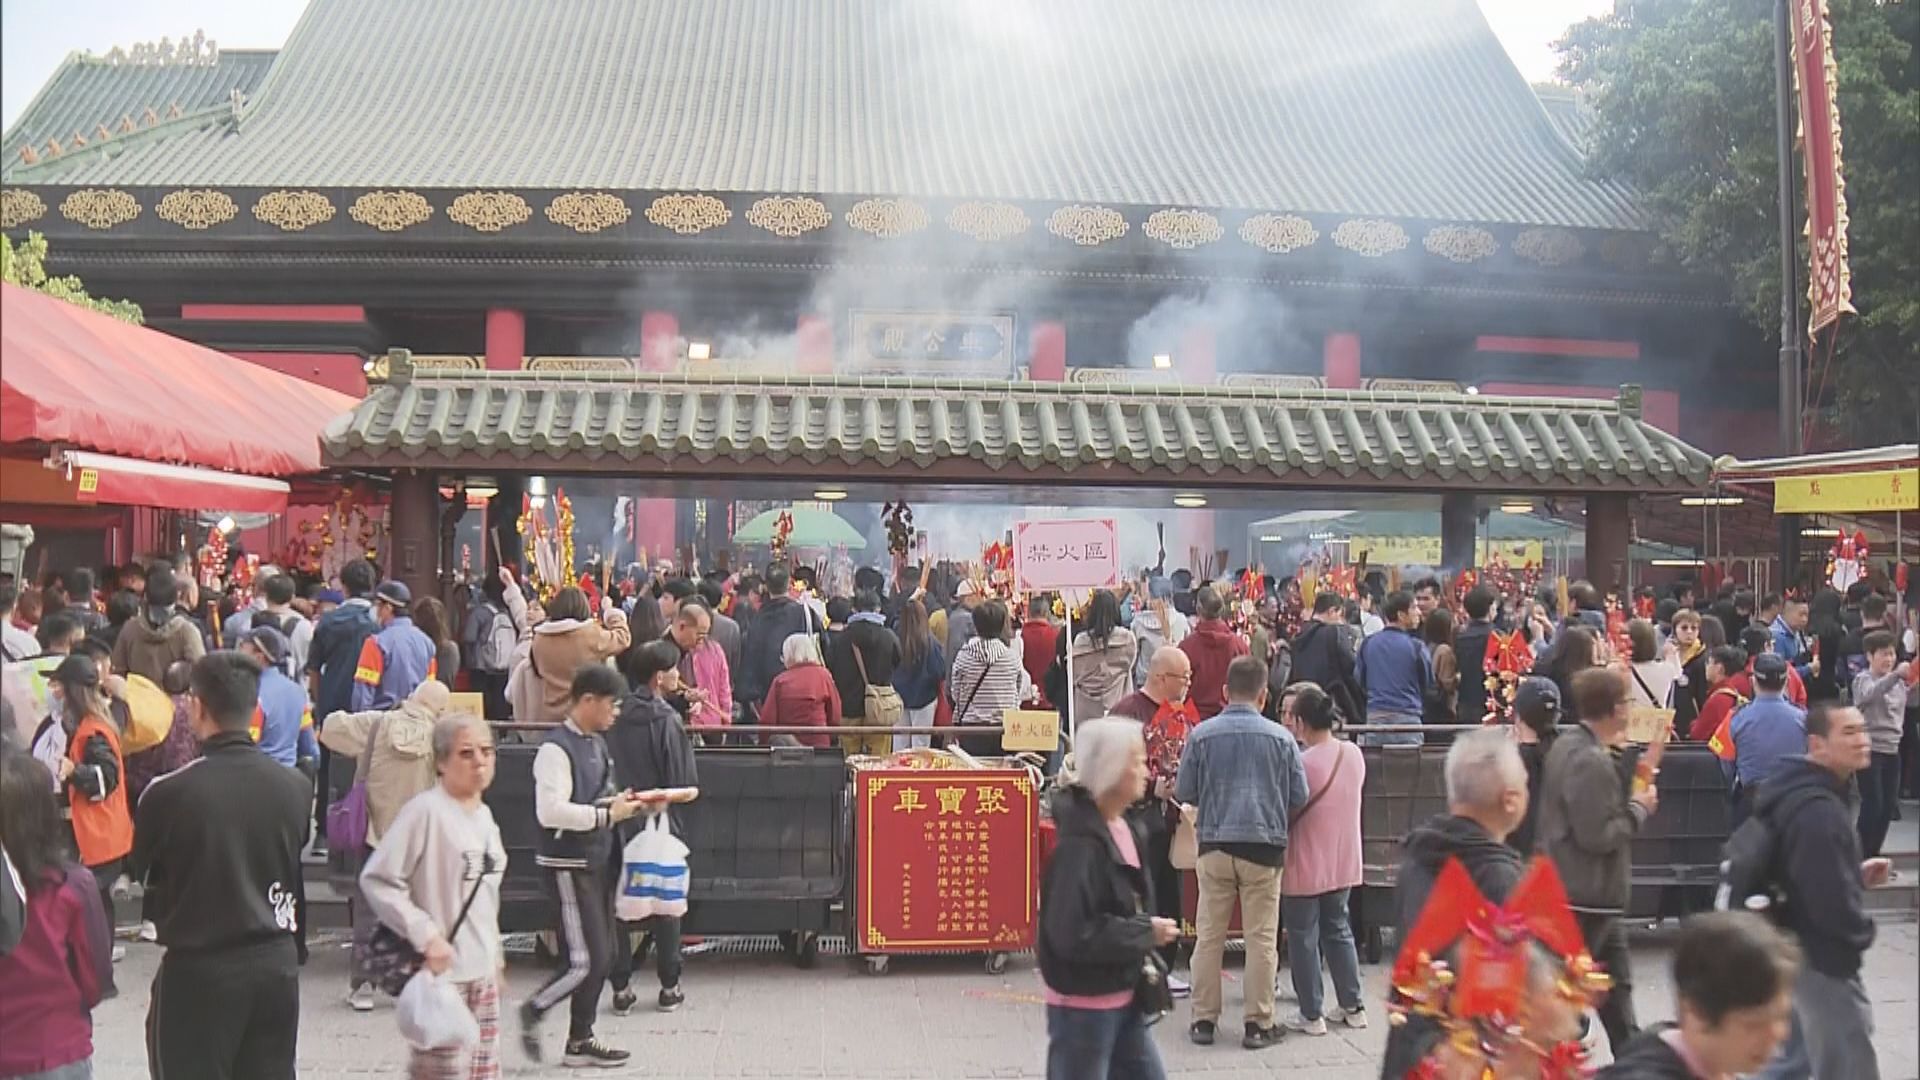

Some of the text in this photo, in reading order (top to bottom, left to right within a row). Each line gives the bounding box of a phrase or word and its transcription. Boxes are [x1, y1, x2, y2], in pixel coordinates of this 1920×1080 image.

[1027, 542, 1107, 563] 禁火區
[1011, 721, 1053, 737] 禁火區
[893, 786, 1010, 816] 聚寶車
